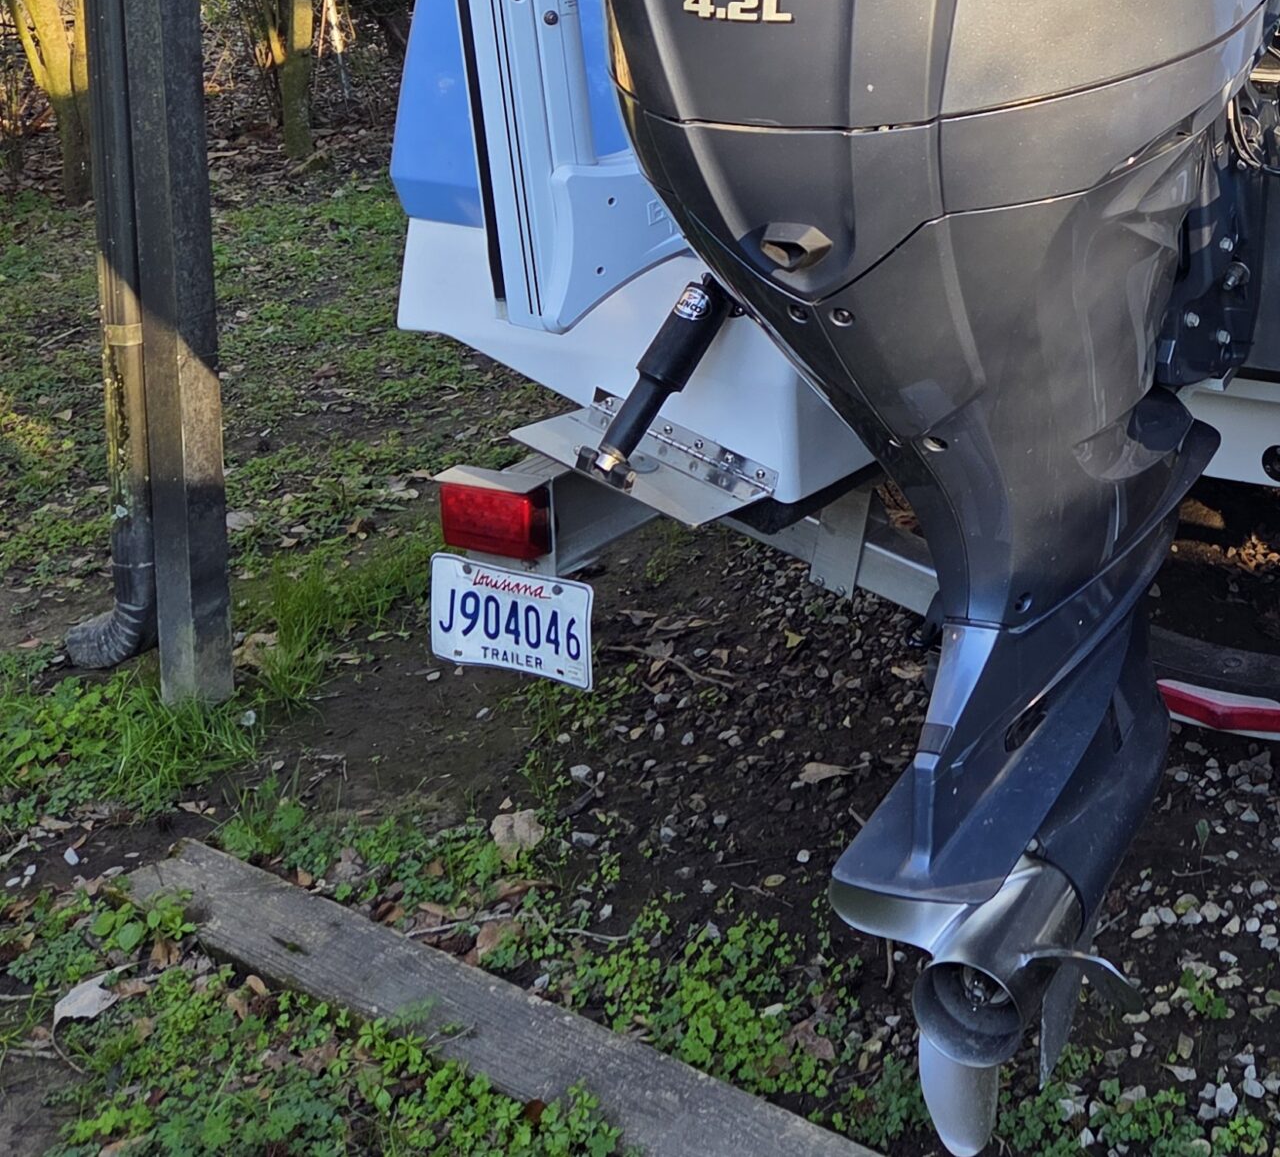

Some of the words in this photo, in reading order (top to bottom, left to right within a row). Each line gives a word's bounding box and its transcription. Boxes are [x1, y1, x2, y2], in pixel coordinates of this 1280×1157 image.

[472, 569, 552, 599] Louisiana
[439, 588, 581, 661] J904046
[481, 646, 543, 670] TRAILER
